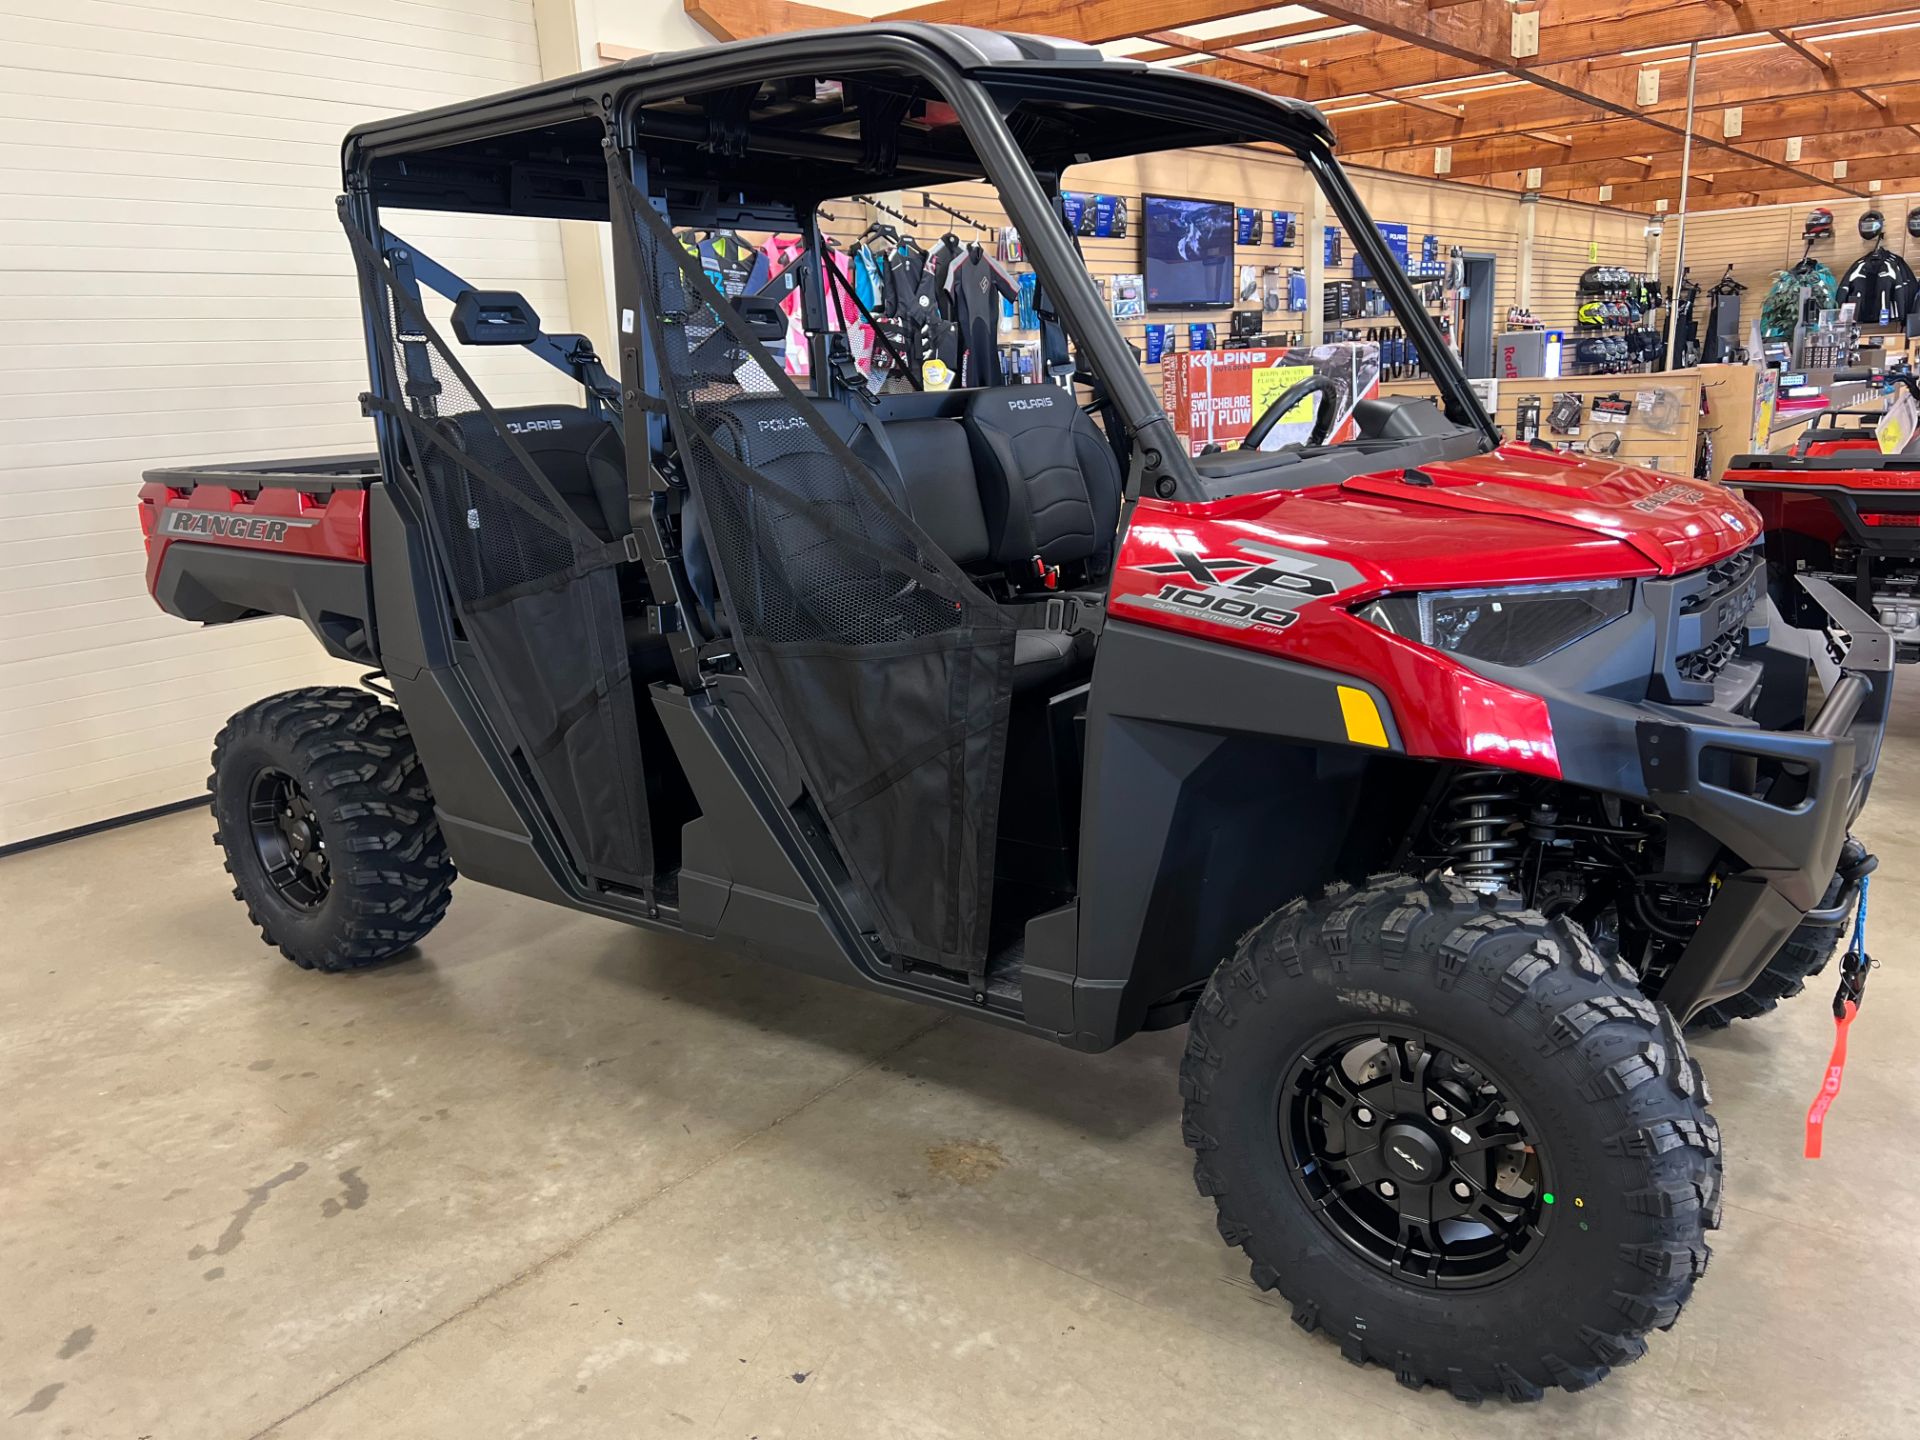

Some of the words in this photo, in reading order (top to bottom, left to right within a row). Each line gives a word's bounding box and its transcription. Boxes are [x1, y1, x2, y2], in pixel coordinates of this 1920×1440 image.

[1008, 396, 1054, 411] POLARIS
[494, 419, 563, 437] OLARIS
[758, 416, 810, 432] POLAR
[1218, 408, 1251, 426] PLOW
[172, 511, 288, 543] RANGER
[1121, 547, 1340, 598] XP
[1156, 583, 1301, 628] 1000
[1152, 602, 1184, 614] DUAL
[1183, 608, 1250, 628] OVERHEAD
[1253, 623, 1284, 635] CAM
